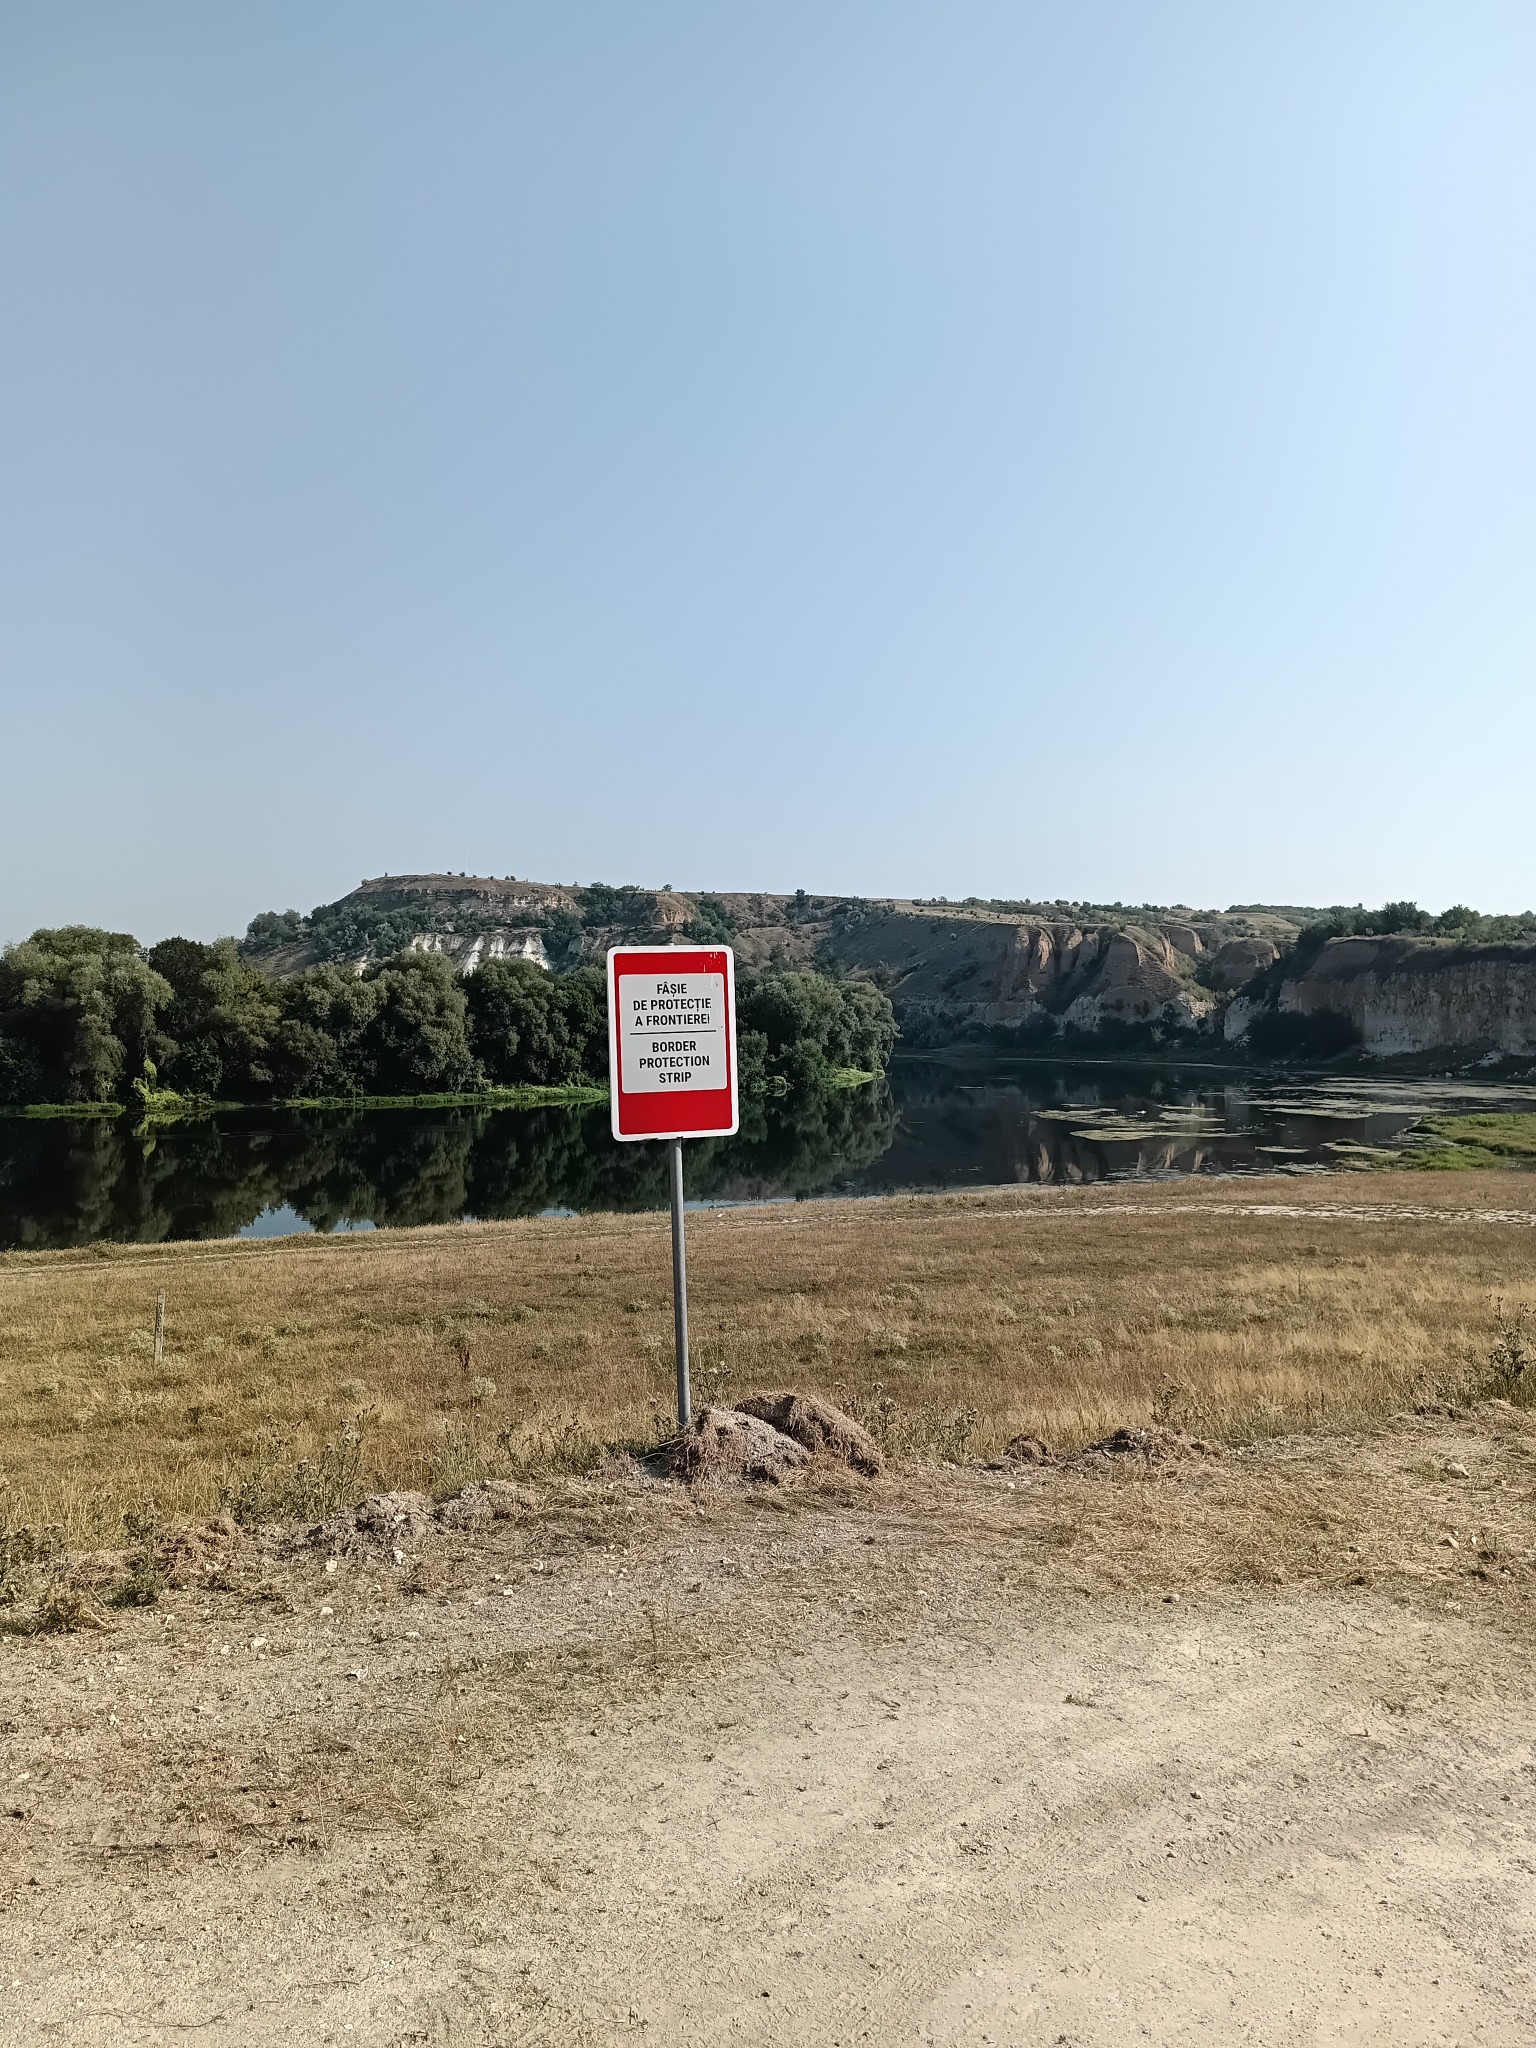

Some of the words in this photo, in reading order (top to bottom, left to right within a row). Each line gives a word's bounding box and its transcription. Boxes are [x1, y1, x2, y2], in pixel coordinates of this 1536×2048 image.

[657, 981, 687, 997] FÂȘIE
[633, 1000, 648, 1011] DE
[651, 998, 711, 1012] PROTECȚIE
[635, 1016, 643, 1026] A
[652, 1041, 696, 1053] BORDER
[639, 1055, 710, 1068] PROTECTION
[659, 1072, 692, 1083] STRIP
